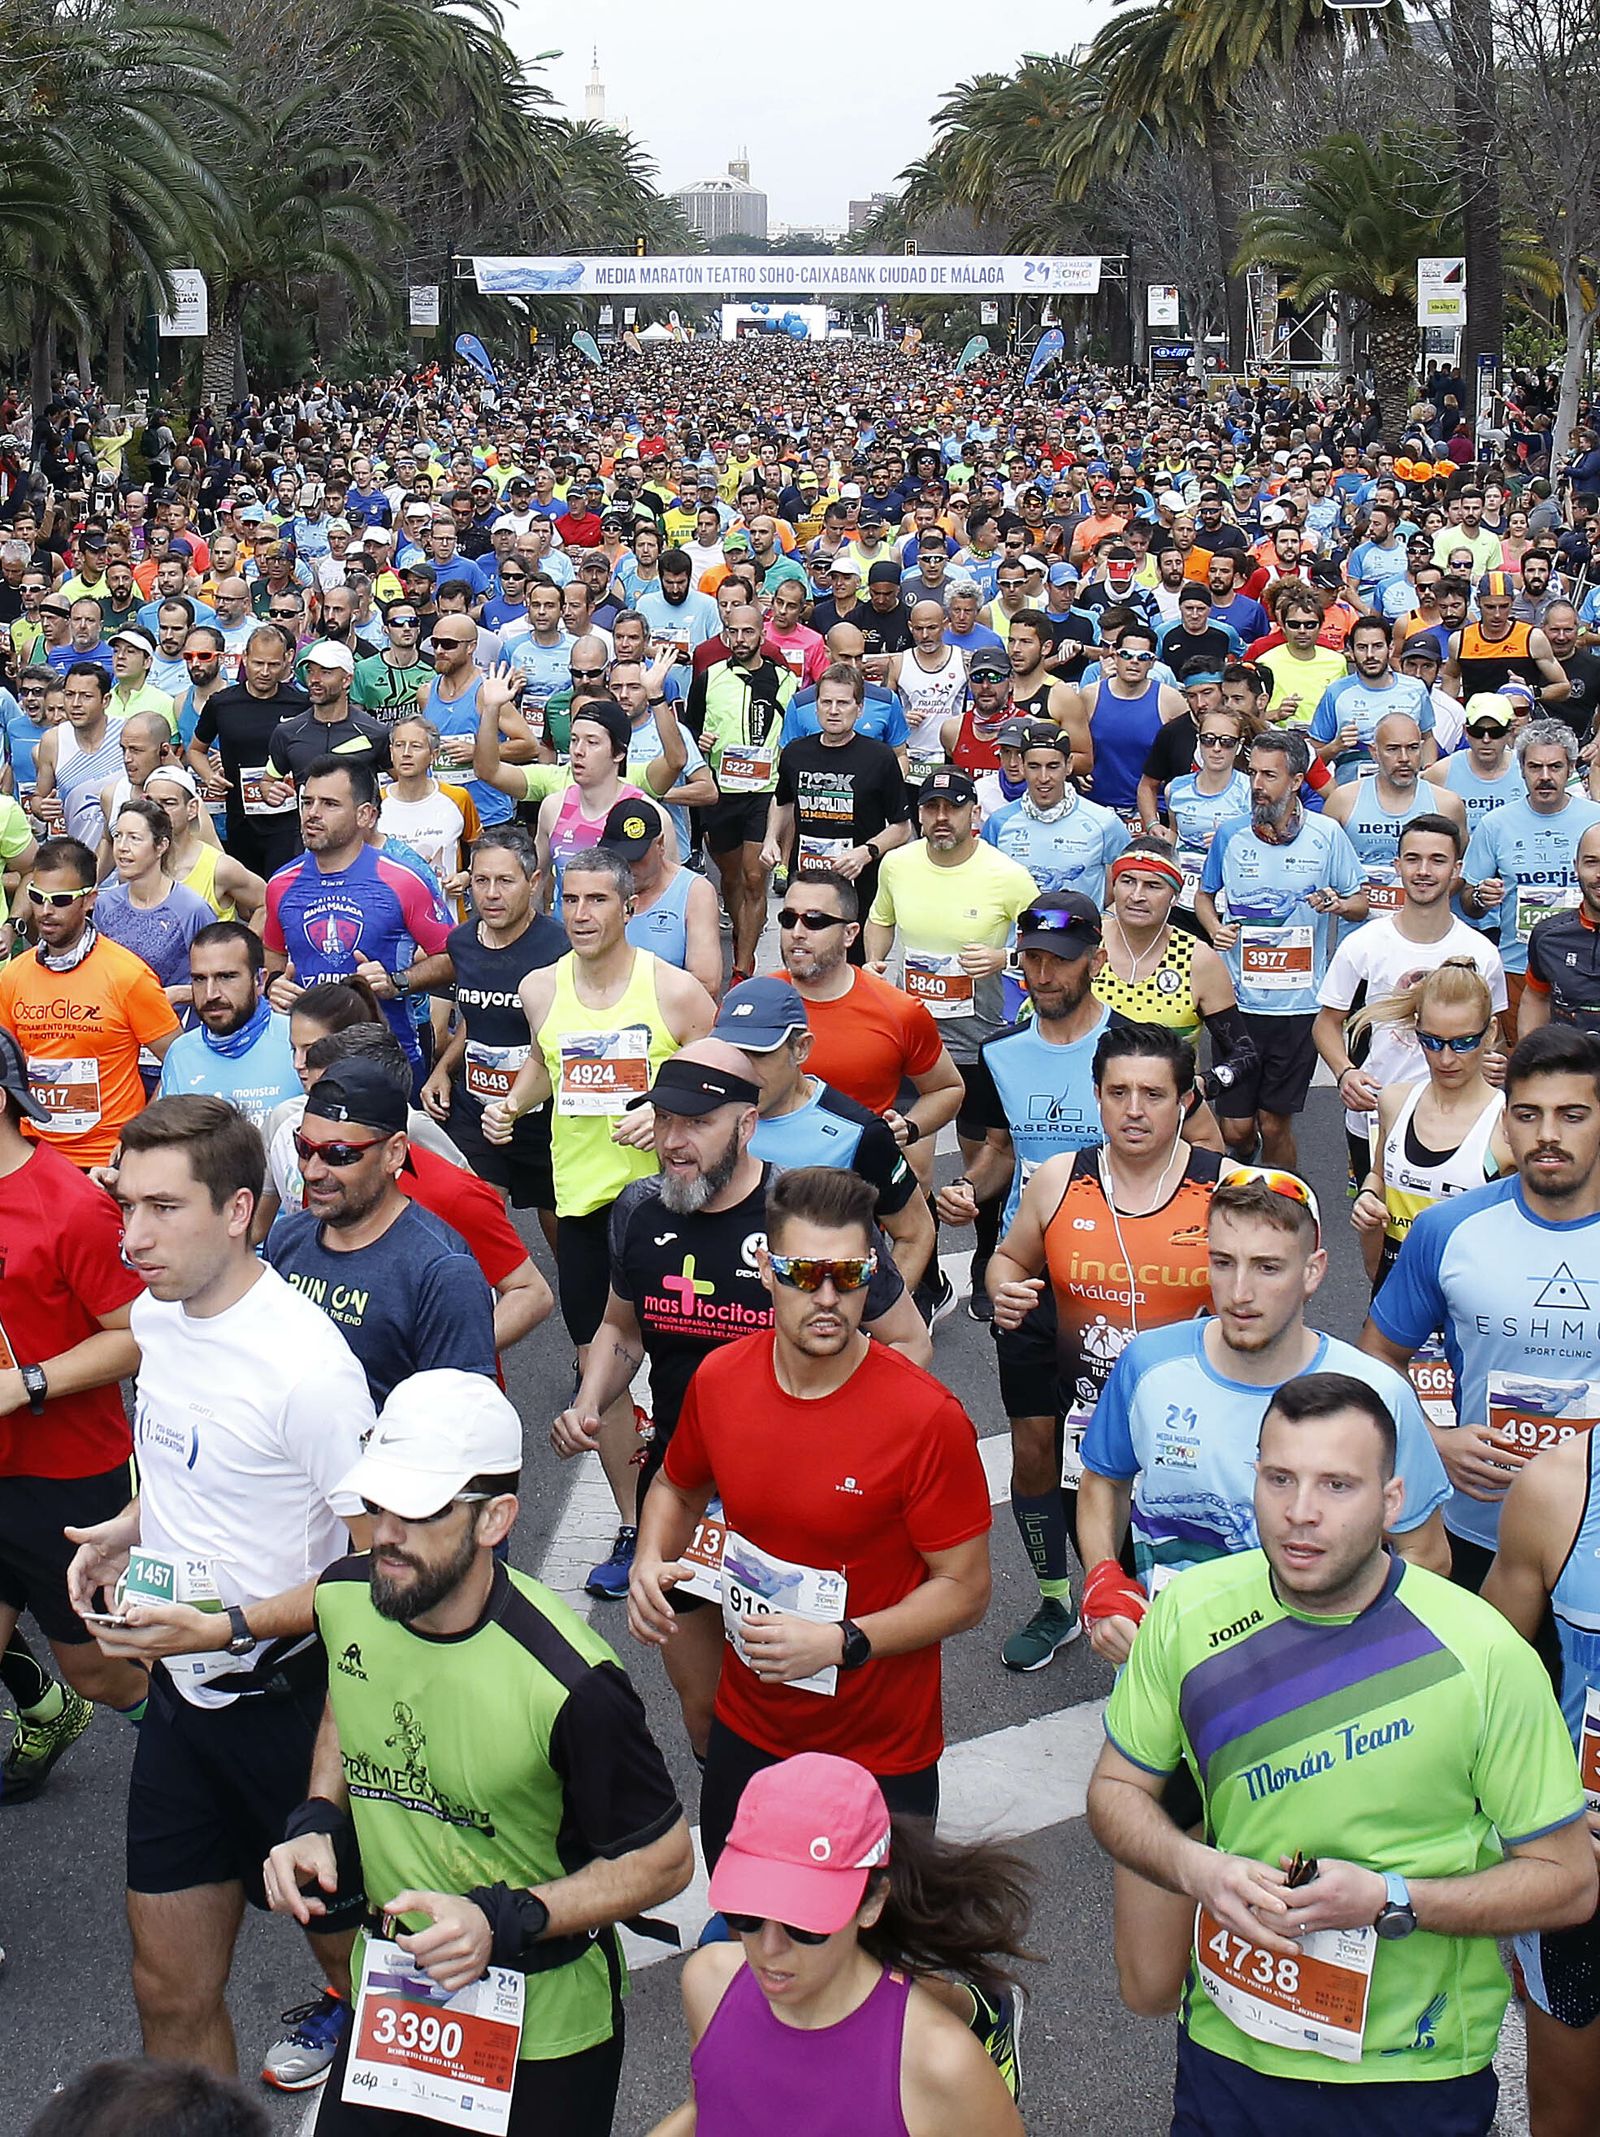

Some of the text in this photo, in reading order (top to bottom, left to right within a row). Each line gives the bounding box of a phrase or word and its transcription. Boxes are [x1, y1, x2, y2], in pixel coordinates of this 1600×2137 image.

[596, 263, 1005, 284] MEDIA MARATÓN TEATRO SOHO-CAIXABANK CIUDAD DE MÁLAGA
[725, 760, 755, 775] 5222
[1248, 950, 1289, 966] 3977
[908, 974, 947, 995] 3840
[471, 1069, 509, 1090] 4848
[569, 1064, 616, 1085] 4924
[232, 1086, 280, 1098] movistar
[331, 1285, 369, 1316] ON
[1068, 1283, 1147, 1307] Málaga
[329, 1309, 362, 1327] THE END
[1524, 1346, 1593, 1359] SPORT CLINIC
[1165, 1404, 1198, 1431] 24
[135, 1560, 171, 1588] 1457
[1208, 1608, 1265, 1648] Joma
[1237, 1716, 1415, 1802] Morán Team
[350, 1785, 368, 1797] Club
[368, 1790, 381, 1798] de
[1208, 1928, 1300, 1994] 4738
[497, 1973, 518, 1994] 24
[372, 2007, 463, 2059] 3390
[387, 2047, 419, 2060] ROBERTO
[442, 2059, 465, 2071] AYALA
[352, 2071, 378, 2091] edp
